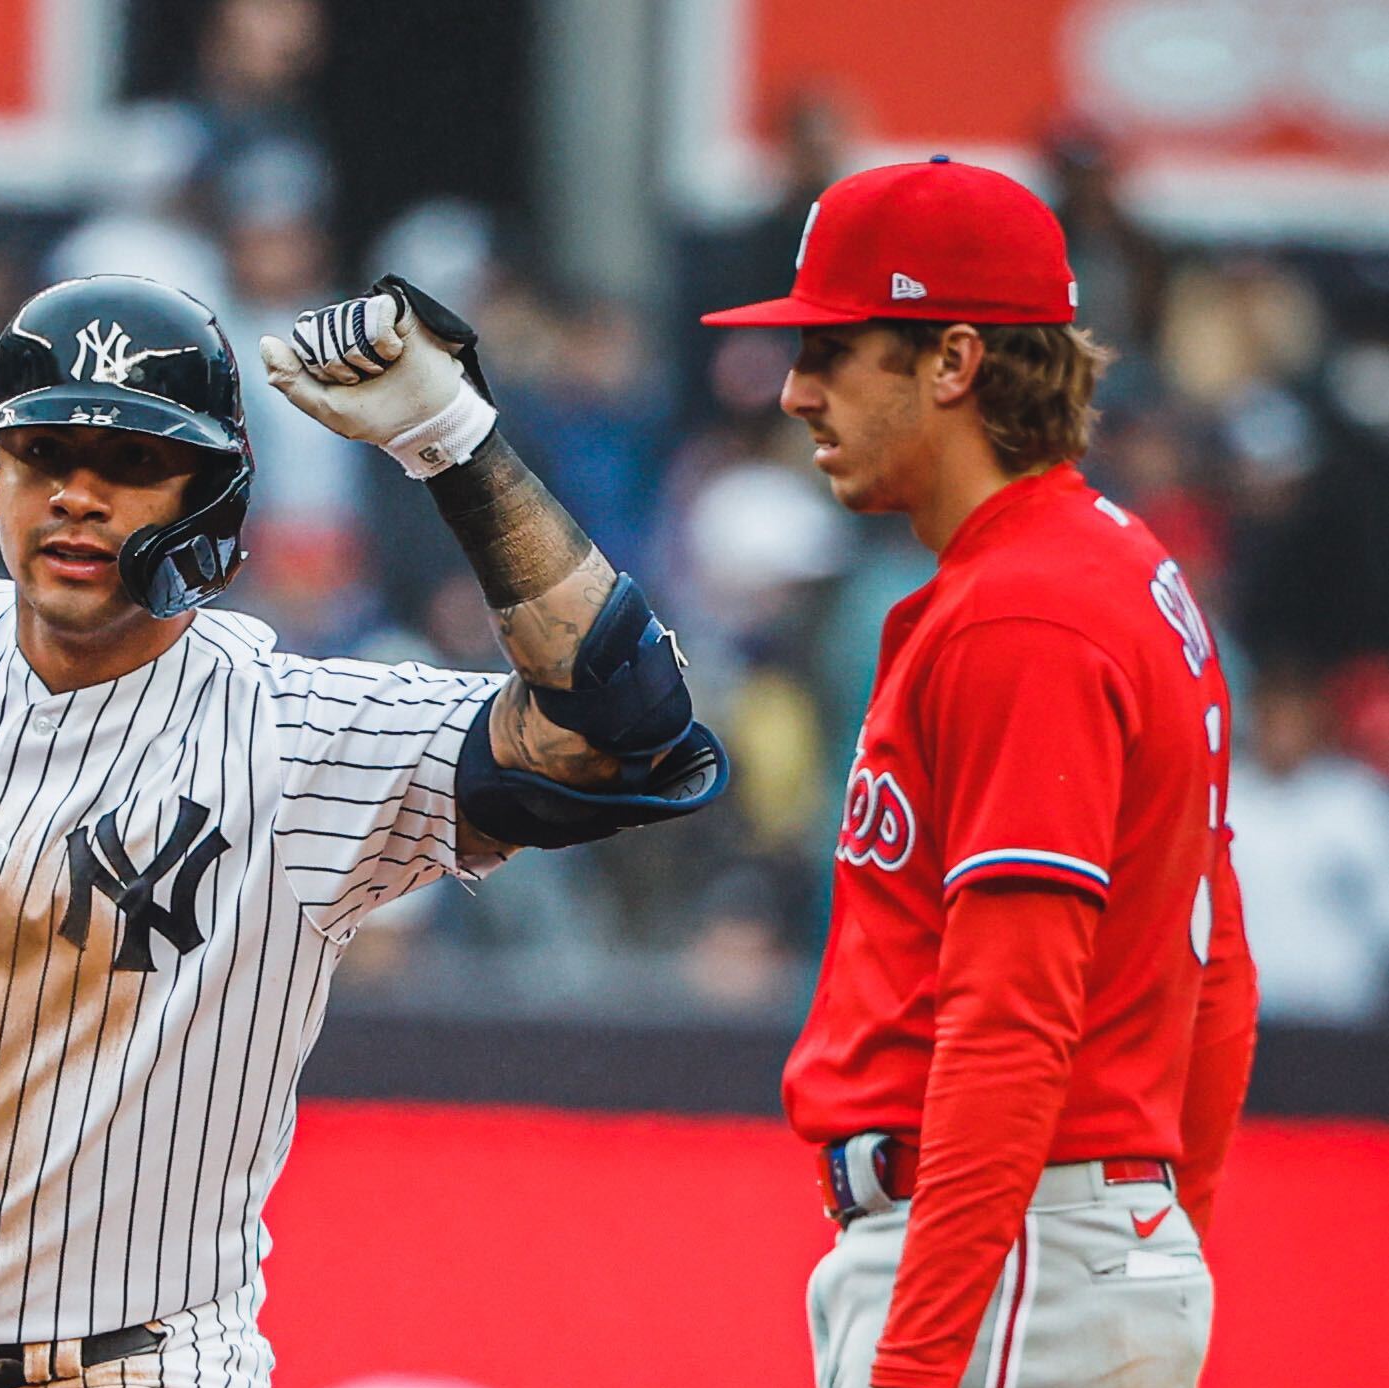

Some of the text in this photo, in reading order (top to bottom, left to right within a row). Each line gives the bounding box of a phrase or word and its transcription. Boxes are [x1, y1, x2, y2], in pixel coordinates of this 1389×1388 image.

[70, 319, 131, 383] NY
[69, 413, 113, 425] 25
[57, 794, 232, 972] NY
